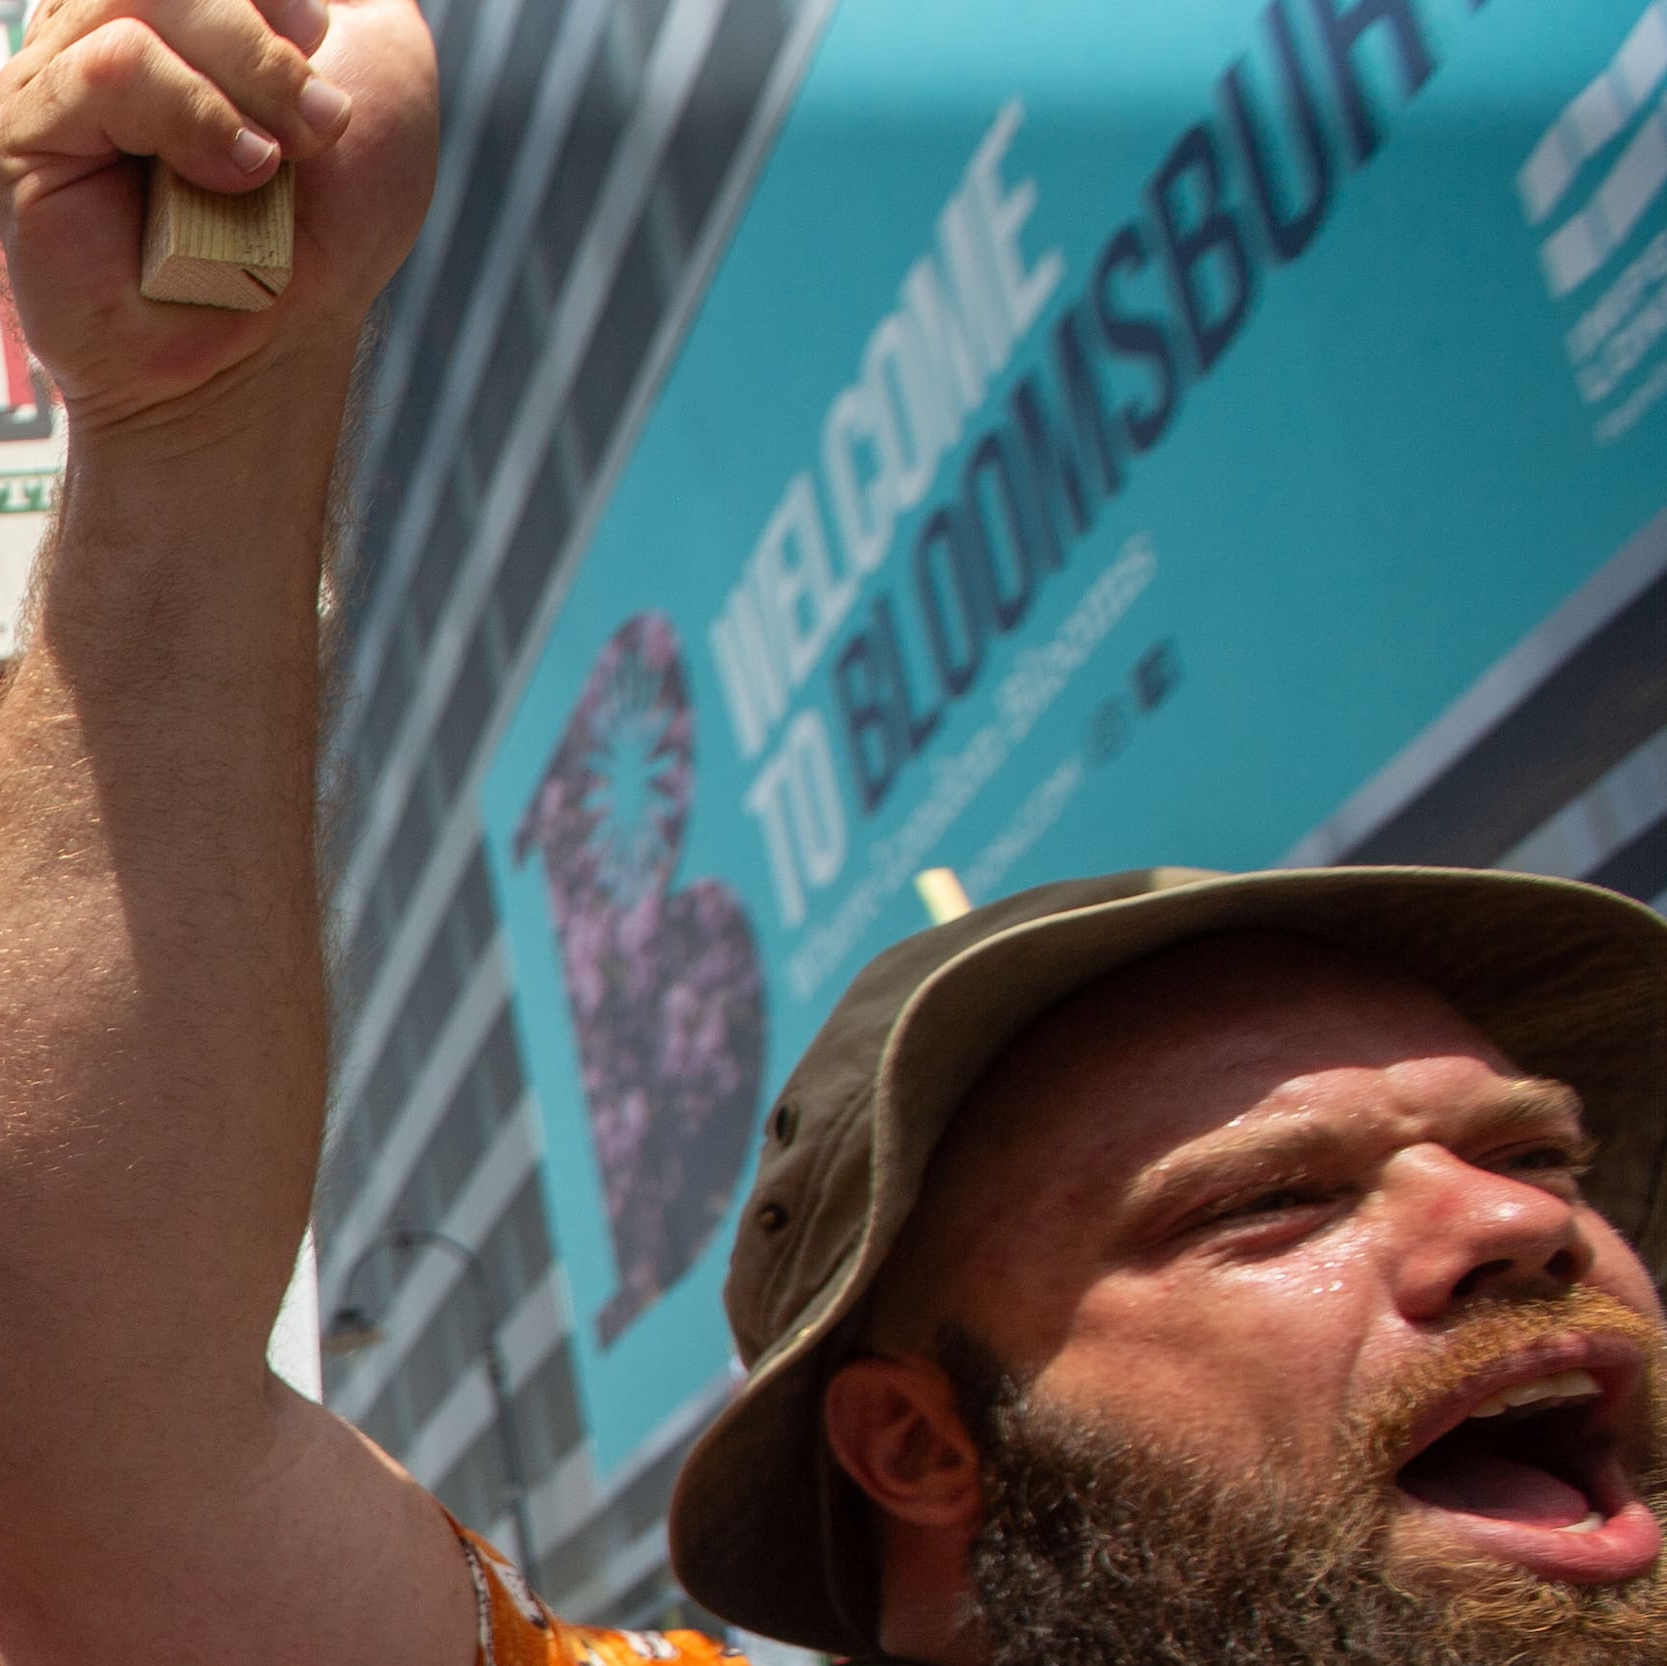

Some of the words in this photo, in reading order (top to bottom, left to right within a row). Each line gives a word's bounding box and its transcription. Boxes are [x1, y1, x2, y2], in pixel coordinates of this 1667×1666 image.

[709, 93, 1065, 760] WELCOME
[749, 709, 847, 928] TO
[833, 0, 1489, 816] BLOOMSBUR
